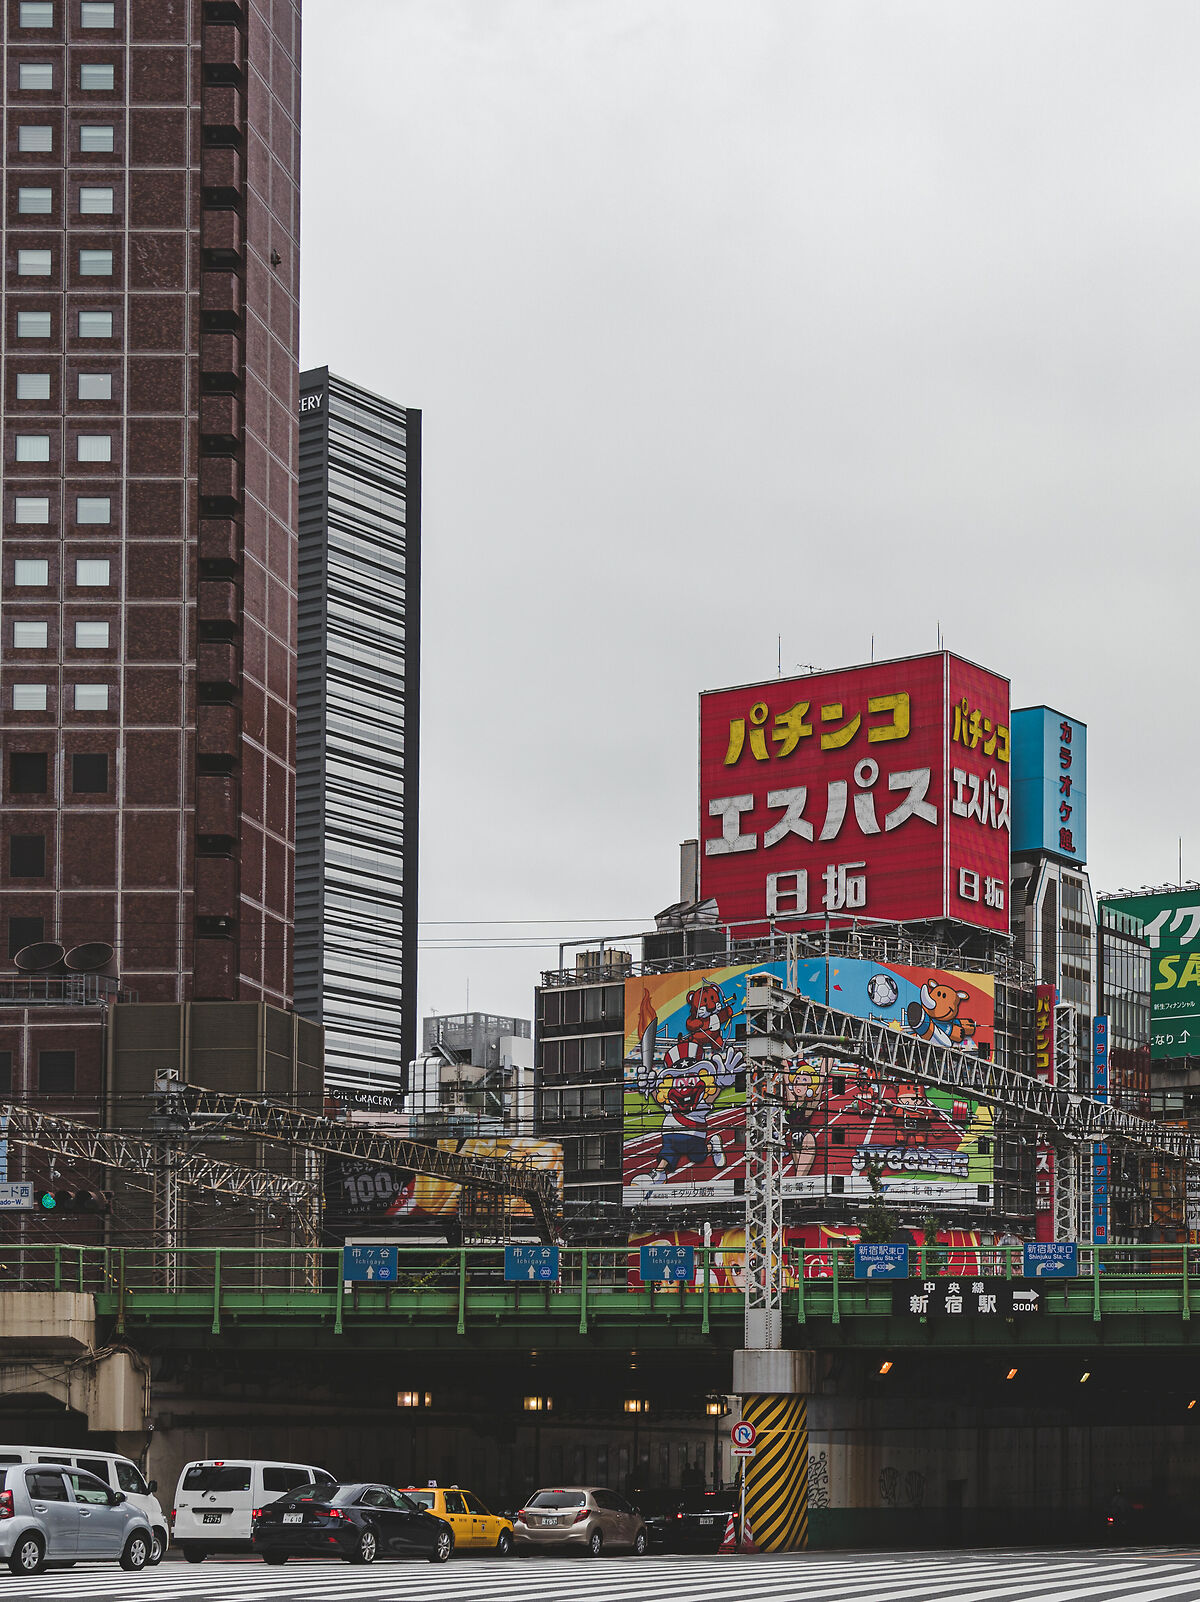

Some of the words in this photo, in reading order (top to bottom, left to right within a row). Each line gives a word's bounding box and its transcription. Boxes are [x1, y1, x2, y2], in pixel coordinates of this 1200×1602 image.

[723, 691, 911, 765] パチンコ
[952, 697, 1010, 763] パチンコ
[952, 767, 1010, 833] エスパス
[1058, 721, 1076, 853] カラオケ館
[705, 757, 938, 856] エスパス
[766, 860, 867, 917] 日拓
[959, 866, 1005, 910] 日拓
[1036, 996, 1050, 1068] パチンコ
[344, 1172, 409, 1205] 100%
[355, 1258, 385, 1266] Ichigaya
[516, 1258, 547, 1266] Ichigaya
[652, 1258, 682, 1266] Ichigaya
[858, 1245, 904, 1255] 新宿駅東口
[1027, 1244, 1073, 1254] 新宿駅東口
[909, 1294, 997, 1313] 新宿駅
[923, 1281, 985, 1293] 中央線
[1012, 1303, 1039, 1311] 300M
